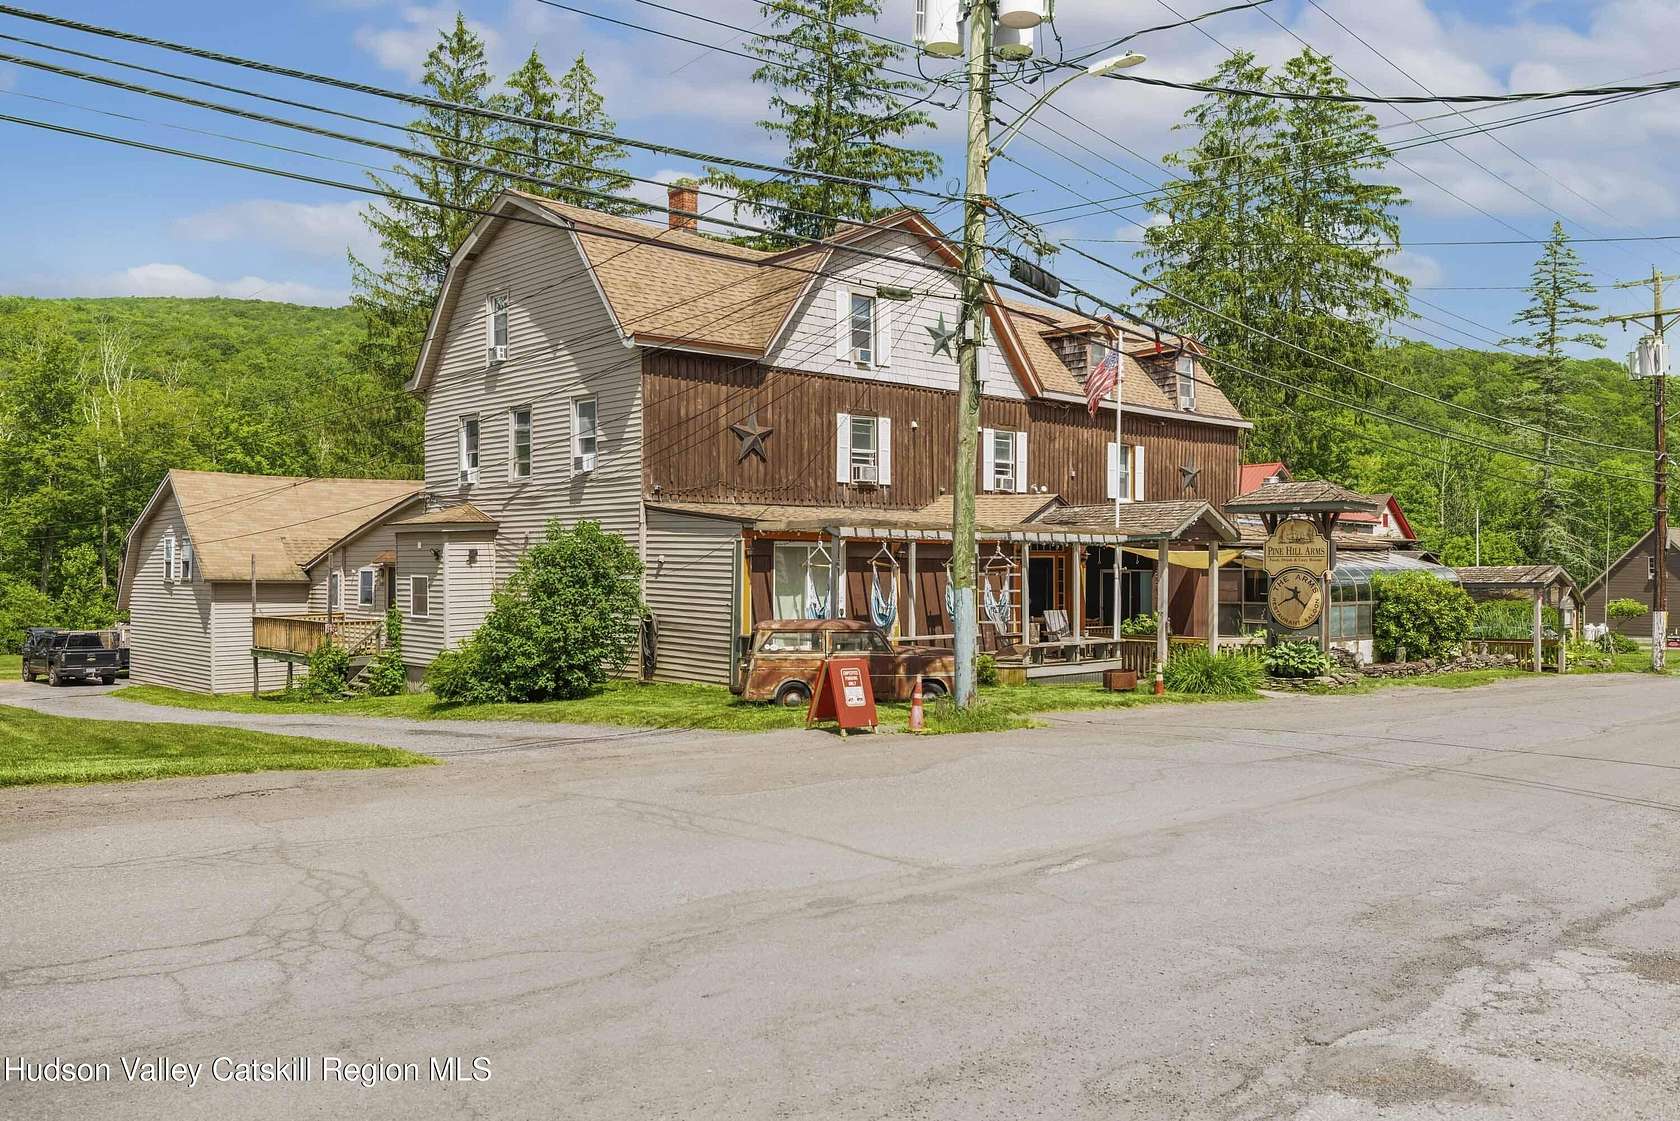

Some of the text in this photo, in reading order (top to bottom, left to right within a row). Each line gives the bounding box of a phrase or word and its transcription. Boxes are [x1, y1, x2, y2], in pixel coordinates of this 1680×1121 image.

[1268, 546, 1325, 556] PINE HILL ARMS
[1273, 574, 1318, 593] THE ARMS
[1272, 597, 1320, 626] RESTAURANT SALOON
